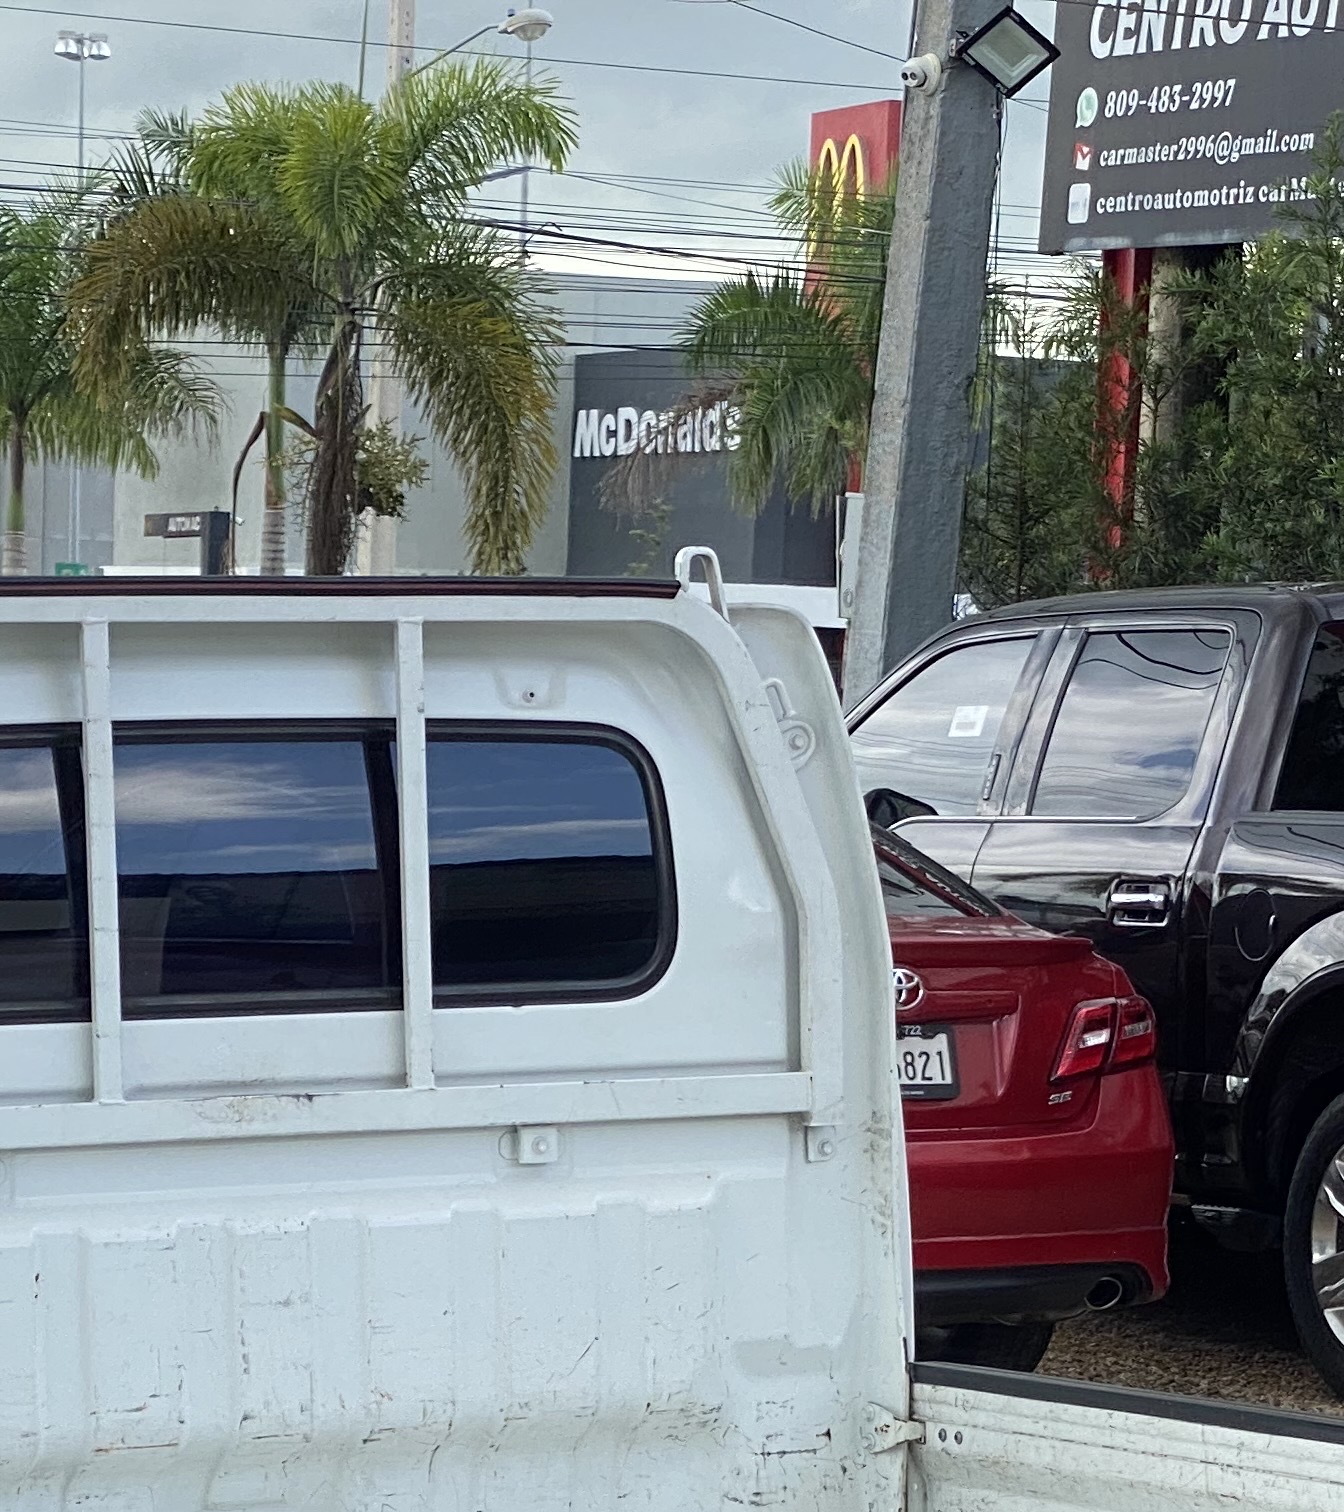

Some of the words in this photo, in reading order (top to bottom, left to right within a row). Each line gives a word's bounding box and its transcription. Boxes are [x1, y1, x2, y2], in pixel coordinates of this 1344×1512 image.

[1104, 78, 1236, 118] 809-483-2997
[1099, 129, 1314, 167] carmaster2996@gmail.com
[1096, 180, 1255, 214] centroautomotriz
[896, 1051, 946, 1081] 821
